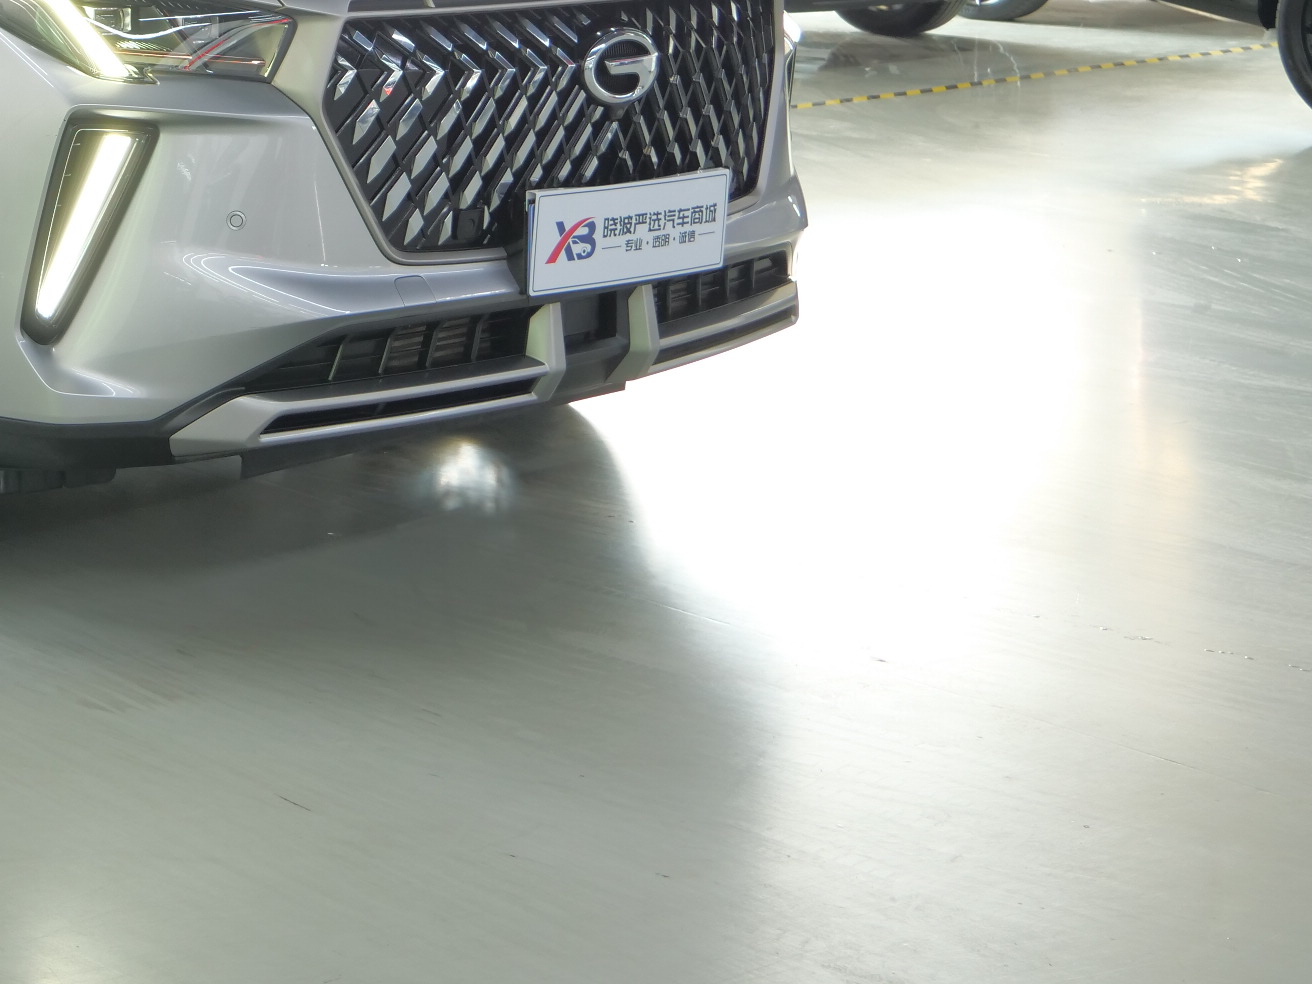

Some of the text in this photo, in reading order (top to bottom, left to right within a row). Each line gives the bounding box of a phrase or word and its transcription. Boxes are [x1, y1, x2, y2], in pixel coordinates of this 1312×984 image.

[602, 203, 718, 238] 晓波严选汽车商城
